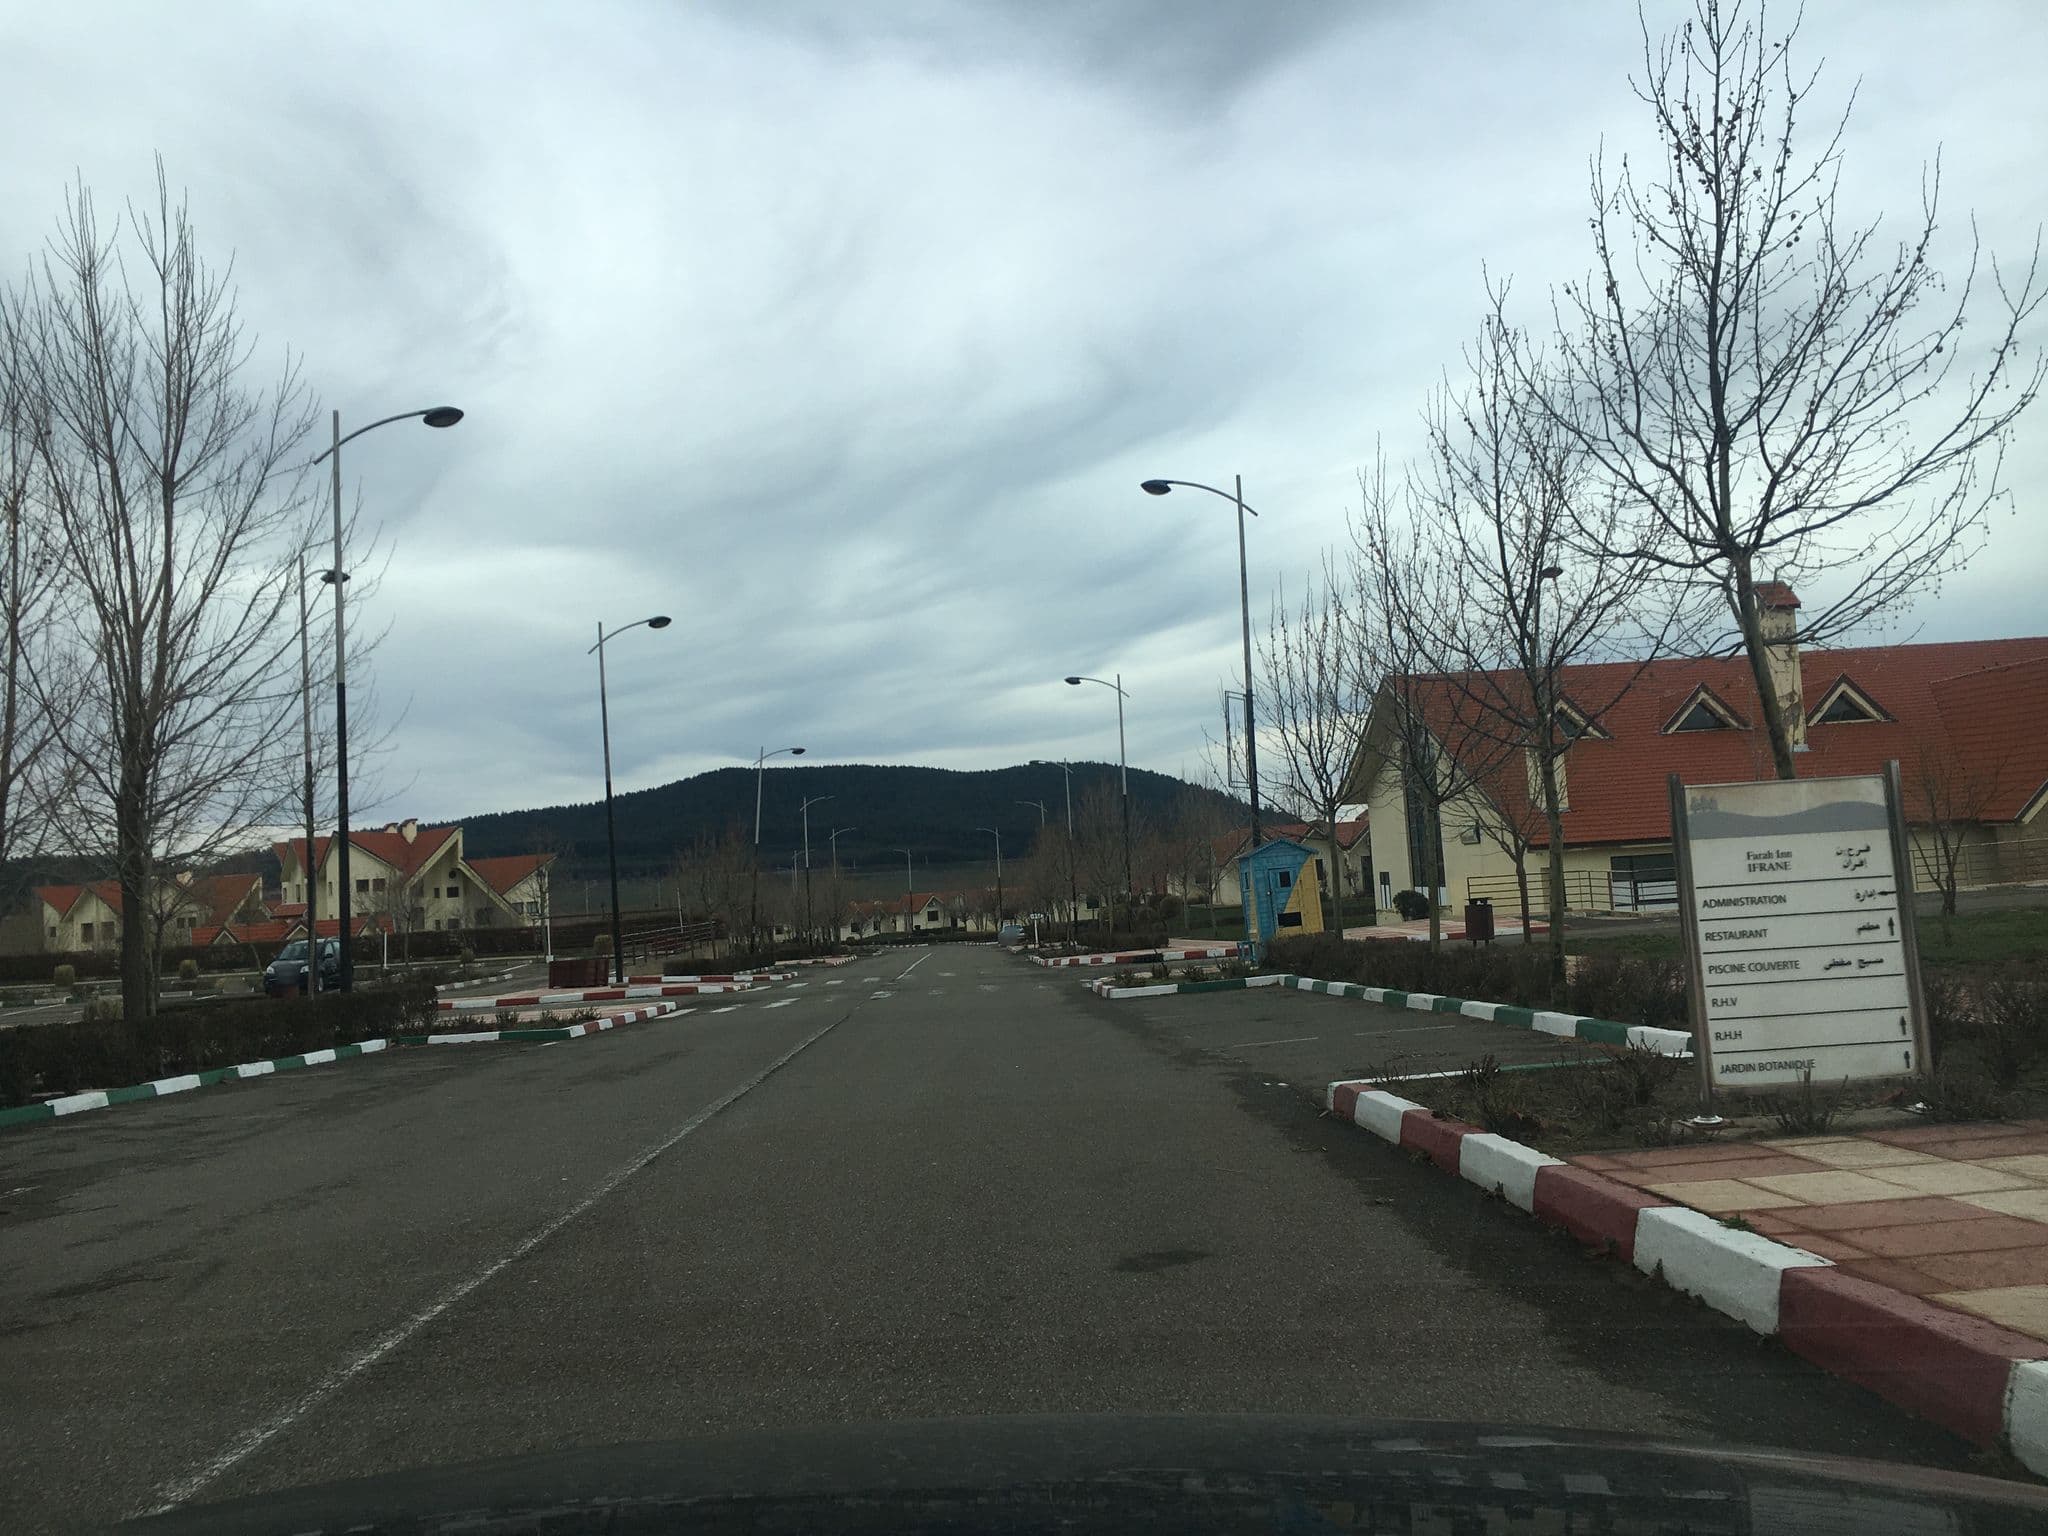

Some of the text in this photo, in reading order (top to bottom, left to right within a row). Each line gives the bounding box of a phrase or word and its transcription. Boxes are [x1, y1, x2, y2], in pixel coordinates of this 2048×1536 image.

[1746, 849, 1793, 860] Farah Inn
[1747, 861, 1792, 873] IFRANE
[1702, 894, 1787, 909] ADMINISTRATION
[1704, 928, 1768, 942] RESTAURANT
[1708, 959, 1801, 975] PISCINE COUVERTE
[1720, 1058, 1817, 1074] JARDIN BOTANIQUE
